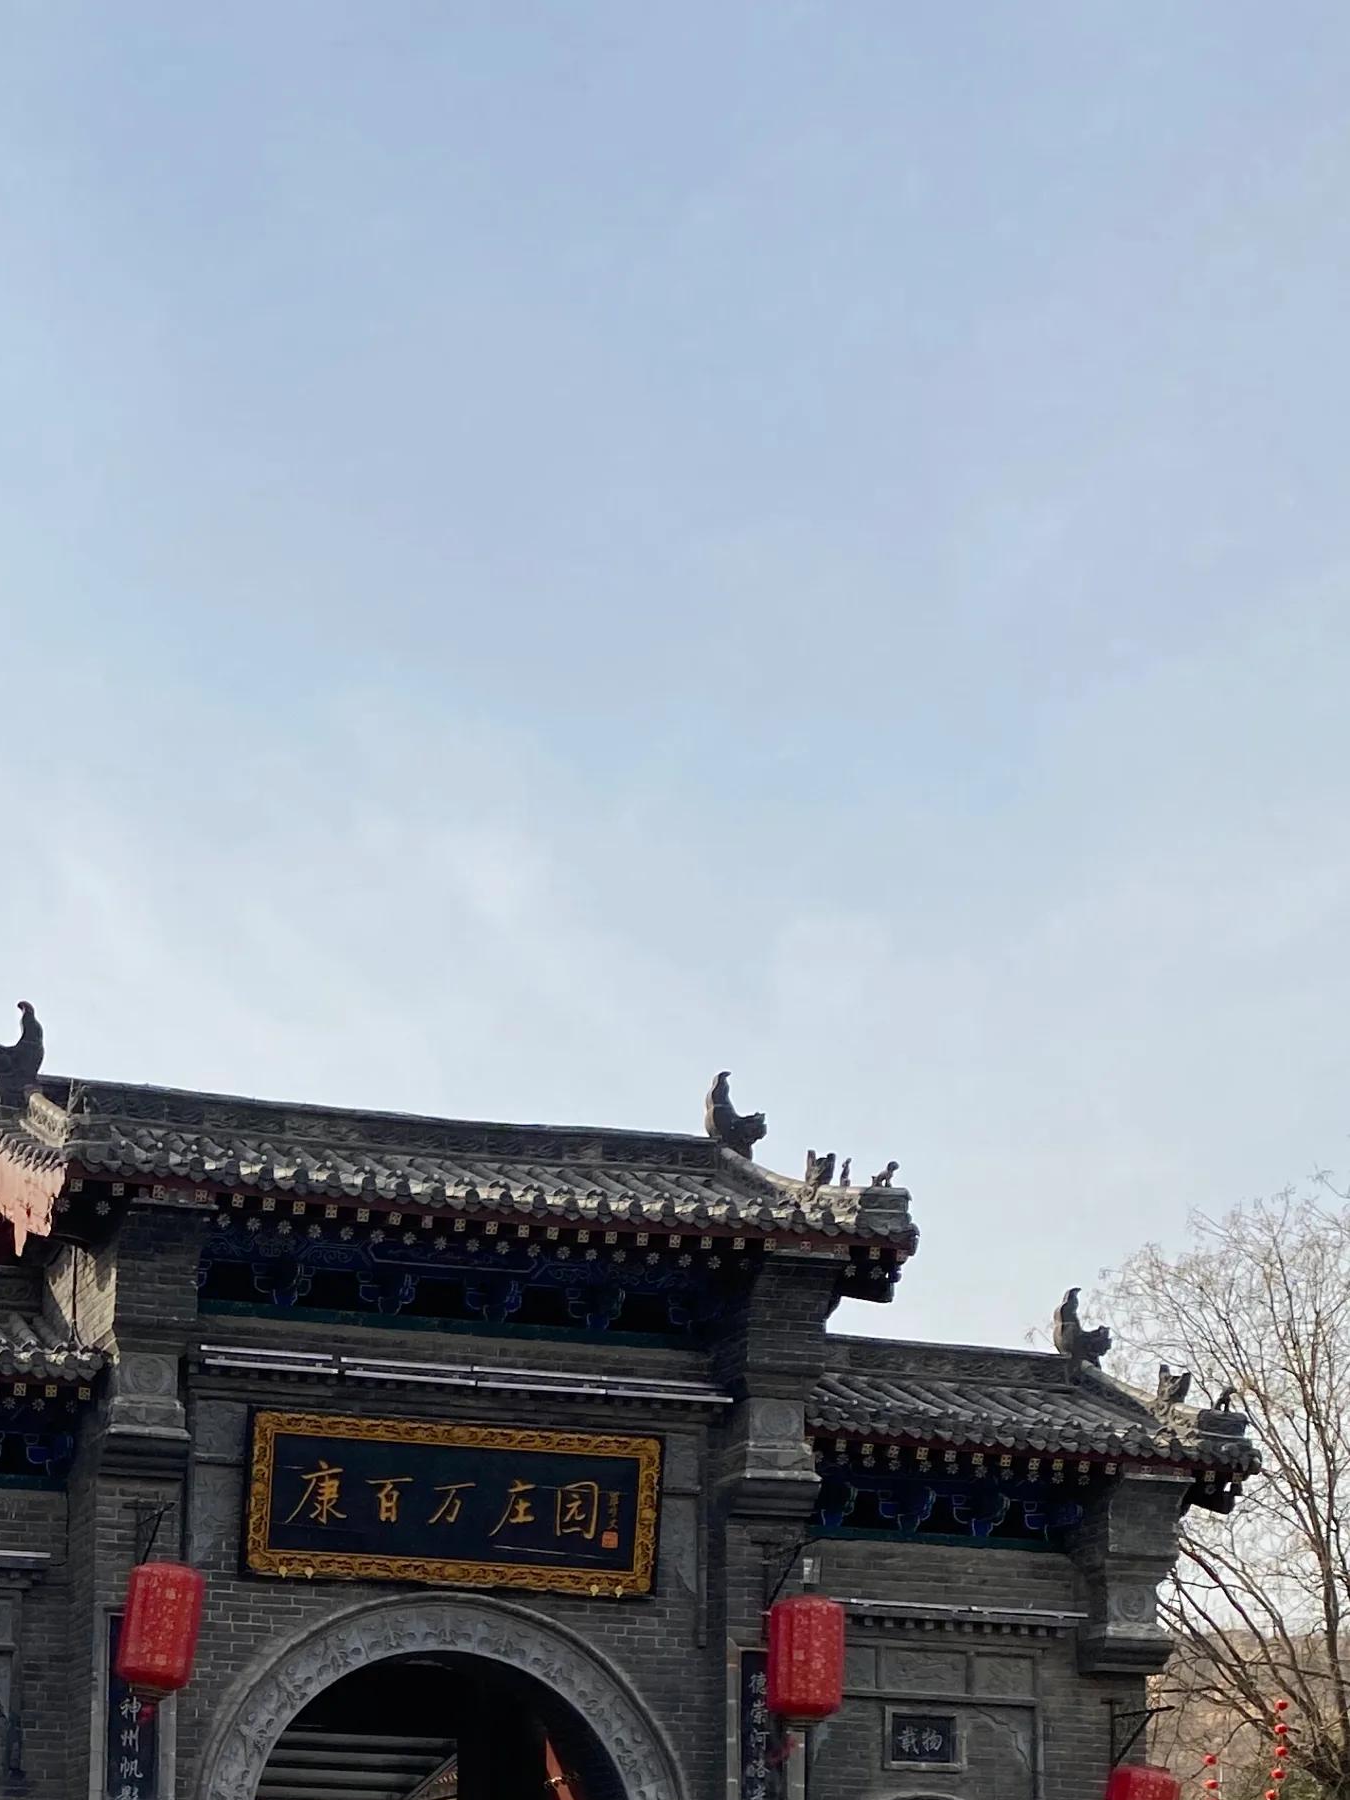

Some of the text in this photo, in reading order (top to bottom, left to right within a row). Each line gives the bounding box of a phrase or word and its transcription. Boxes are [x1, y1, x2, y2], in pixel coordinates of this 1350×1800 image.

[285, 1460, 599, 1540] 康百万庄园
